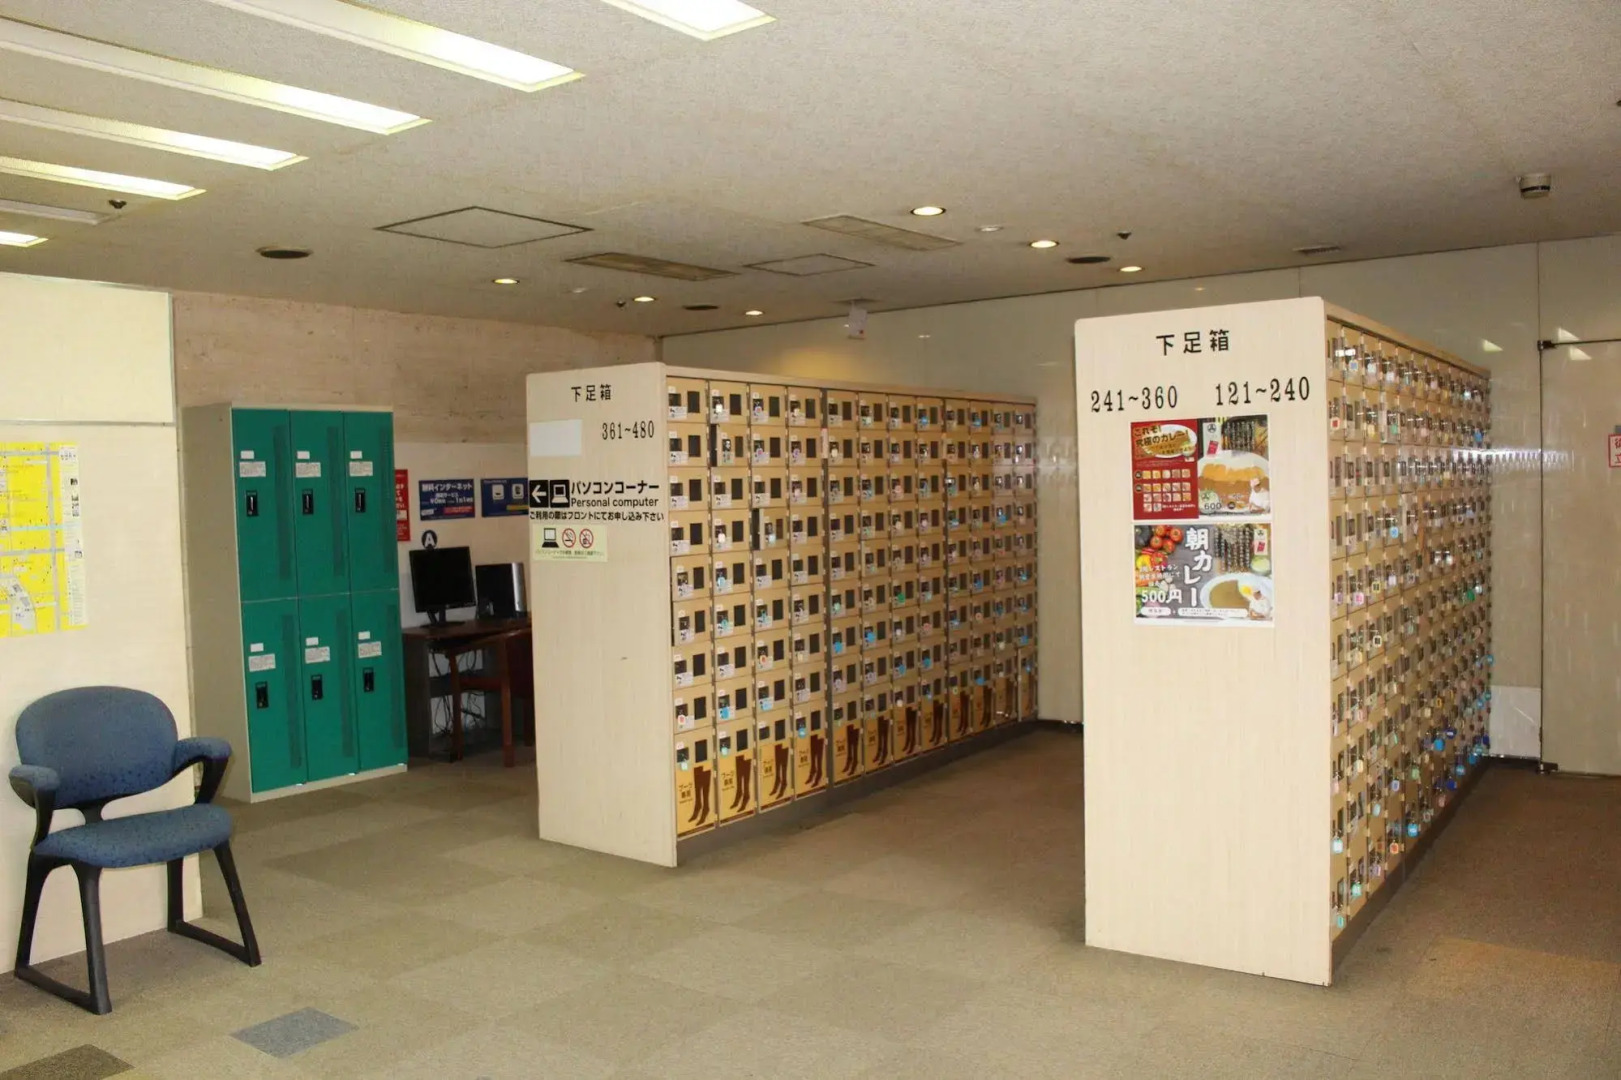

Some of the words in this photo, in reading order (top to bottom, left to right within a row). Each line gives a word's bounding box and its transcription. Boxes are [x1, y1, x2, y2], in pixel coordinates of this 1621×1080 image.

[1156, 329, 1230, 356] 下足箱
[571, 384, 612, 402] 下足箱
[1091, 385, 1178, 412] 241~360
[1215, 376, 1310, 406] 121~240
[602, 420, 655, 440] 361~480
[571, 480, 660, 495] パソコンコーナー
[571, 498, 610, 507] Personal
[613, 498, 659, 509] computer
[424, 532, 436, 547] A
[1184, 527, 1212, 607] 朝カレー
[1141, 588, 1183, 605] 500円
